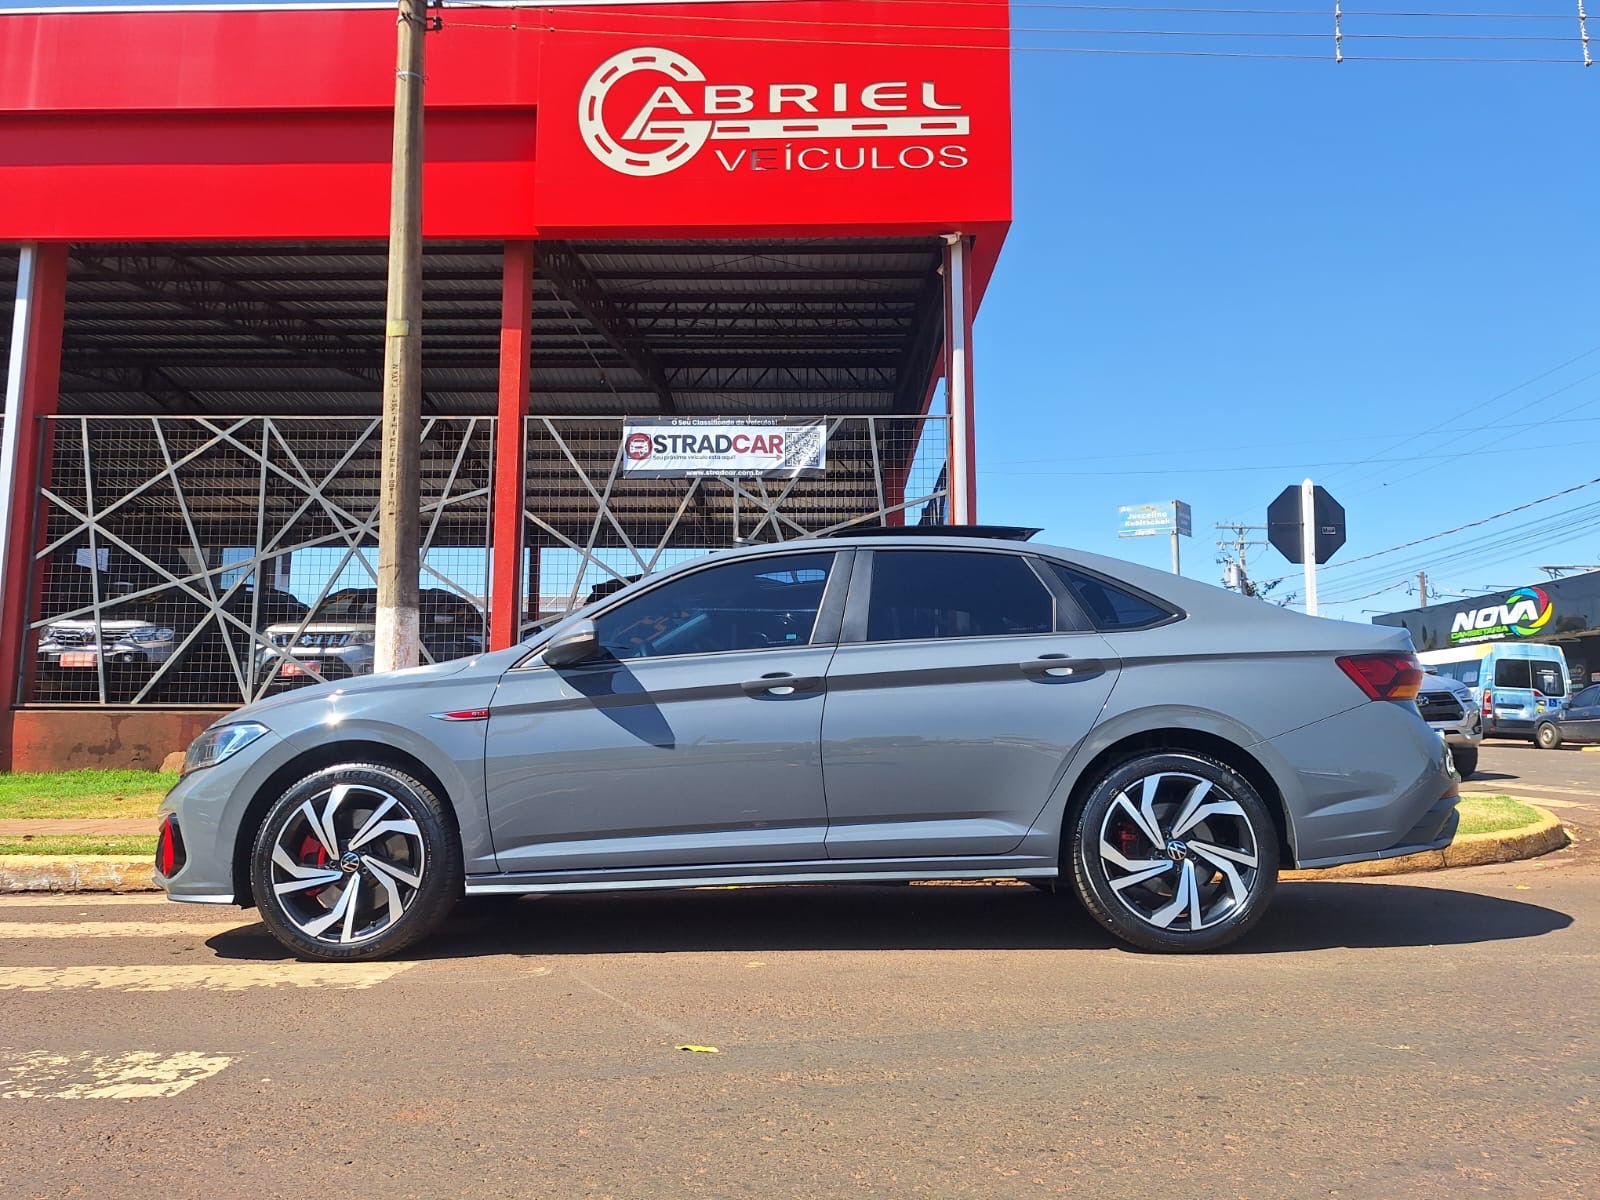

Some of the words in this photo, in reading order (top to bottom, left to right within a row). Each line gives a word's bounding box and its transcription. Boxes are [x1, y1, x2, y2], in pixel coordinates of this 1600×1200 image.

[578, 46, 970, 177] GABRIEL
[714, 144, 969, 171] VEÍCULOS
[653, 434, 784, 454] STRADCAR
[686, 469, 763, 477] www.stradcar.com.br
[1451, 600, 1538, 633] NOVA
